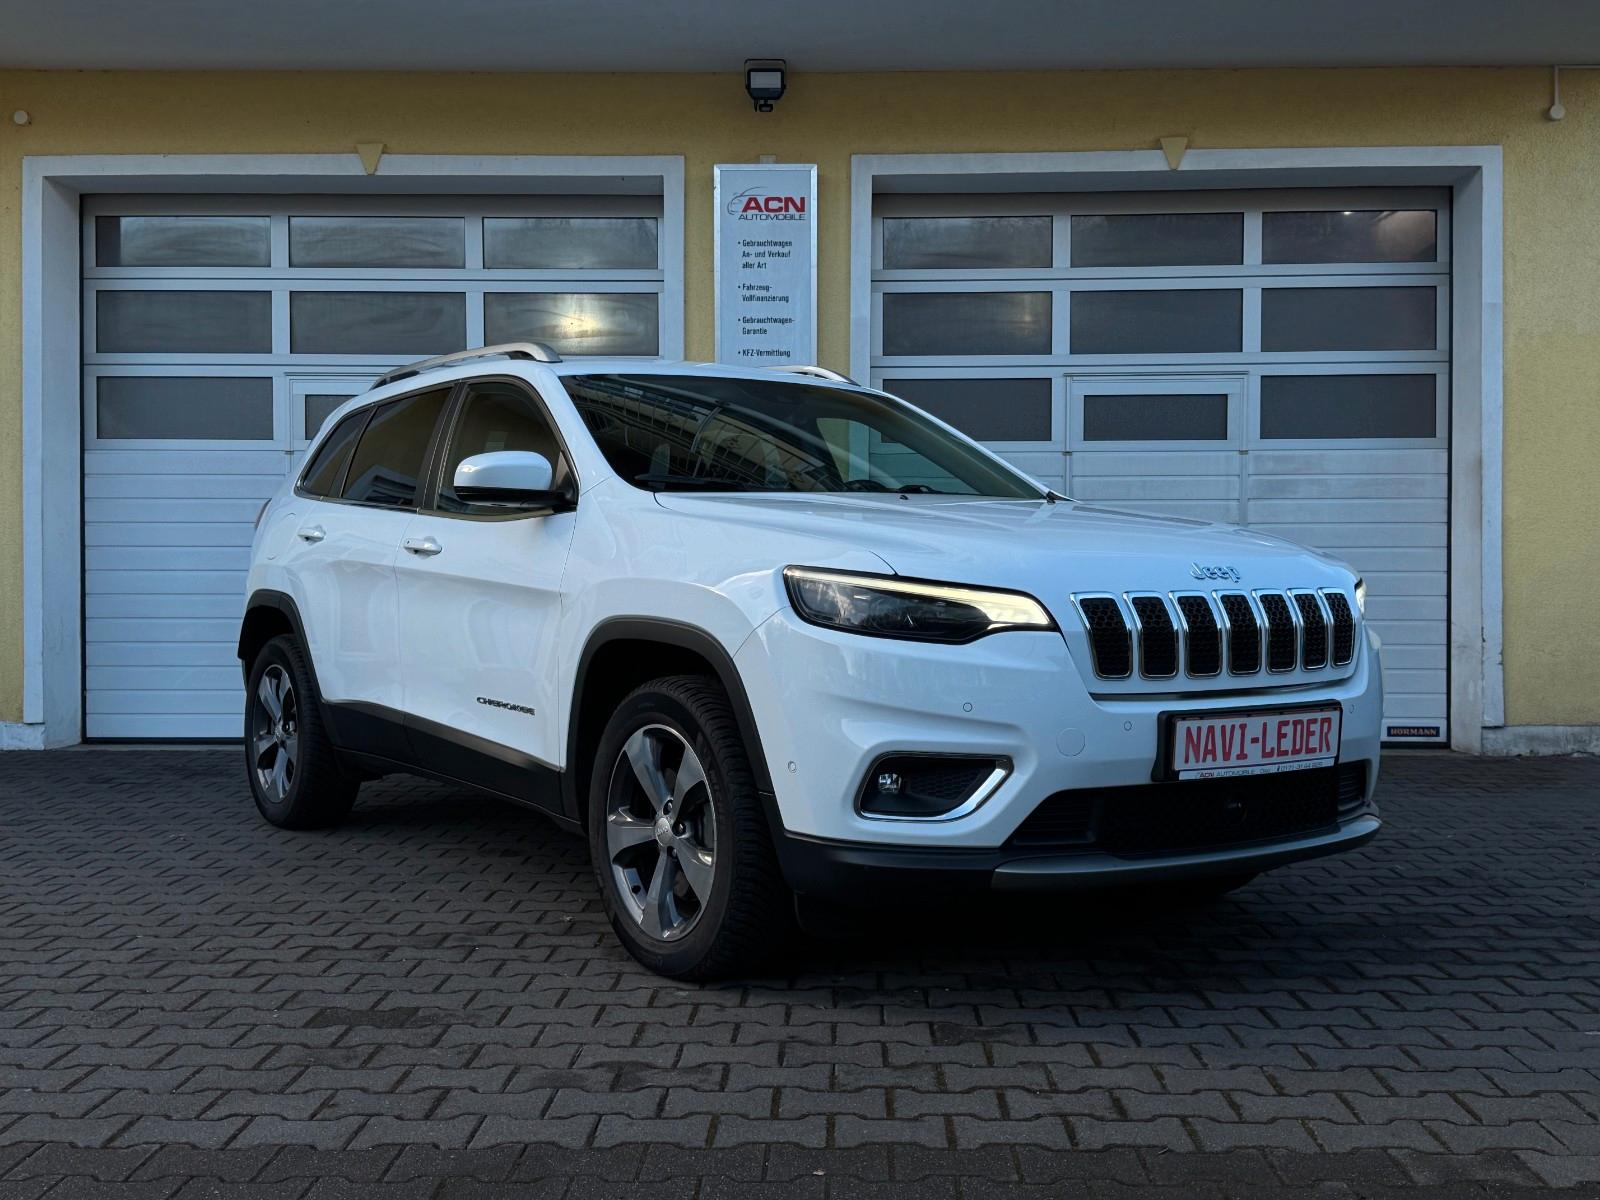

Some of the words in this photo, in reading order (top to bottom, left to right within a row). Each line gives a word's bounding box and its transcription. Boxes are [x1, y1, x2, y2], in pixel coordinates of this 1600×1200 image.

[741, 196, 806, 213] ACN
[738, 213, 806, 221] AUTOMOBILE
[742, 239, 793, 248] Gebrauchtwagen
[742, 250, 752, 258] An-
[754, 250, 766, 258] und
[767, 250, 791, 258] Verkauf
[742, 261, 755, 269] aller
[742, 283, 773, 292] Fahrzeug-
[741, 294, 790, 303] Vollfinanzierung
[742, 316, 796, 325] Gebrauchtwagen-
[742, 327, 768, 335] Garantie
[742, 349, 791, 358] KFZ-Vermittlung
[1190, 562, 1241, 584] Jeep
[476, 696, 536, 716] CHEROKEE
[1184, 717, 1333, 764] NAVI-LEDER
